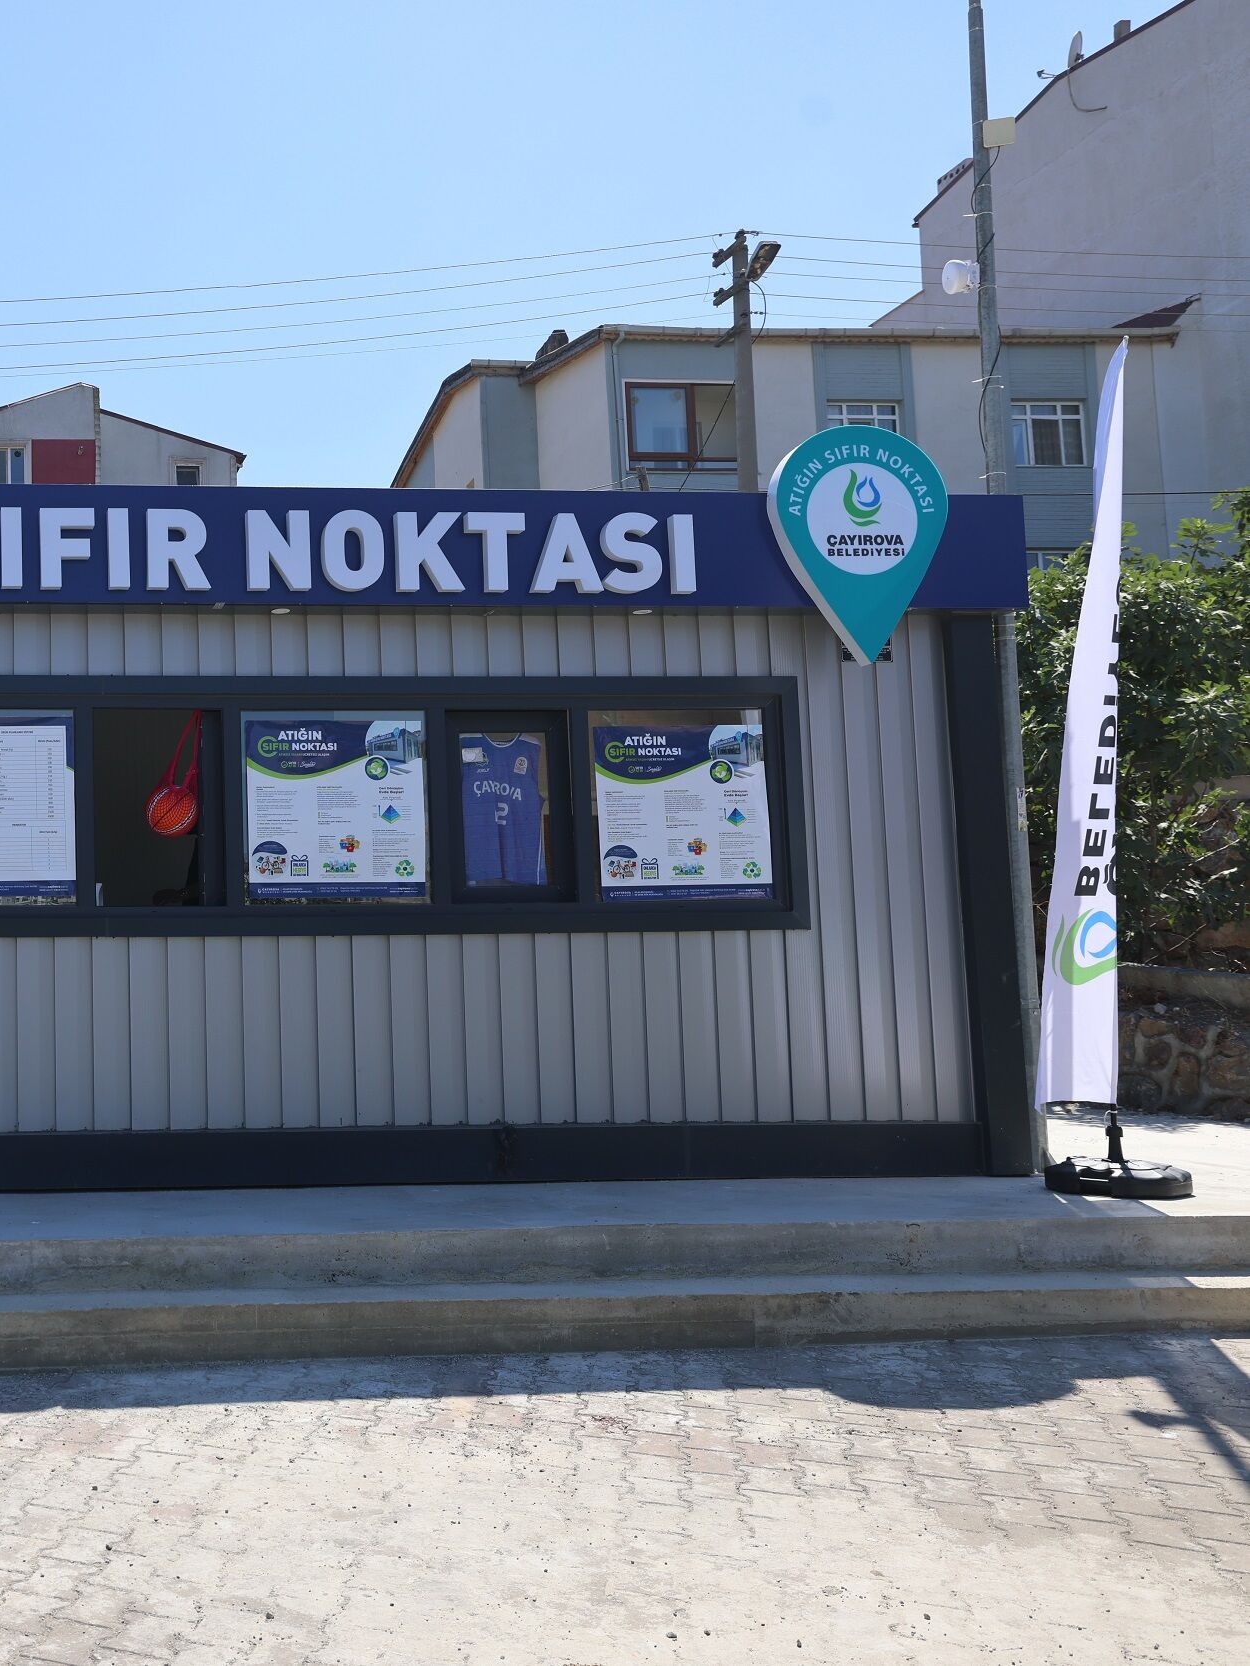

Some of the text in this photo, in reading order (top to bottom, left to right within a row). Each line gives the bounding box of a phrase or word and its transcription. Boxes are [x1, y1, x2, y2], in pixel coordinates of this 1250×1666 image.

[788, 444, 935, 517] ATIĞIN SIFIR NOKTASI
[827, 534, 904, 548] ÇAYIROVA
[245, 509, 696, 595] NOKTASI
[277, 728, 322, 741] ATIĞIN
[624, 734, 666, 746] ATIĞIN
[262, 742, 337, 751] SIFIR NOKTASI
[610, 747, 681, 756] SIFIR NOKTASI
